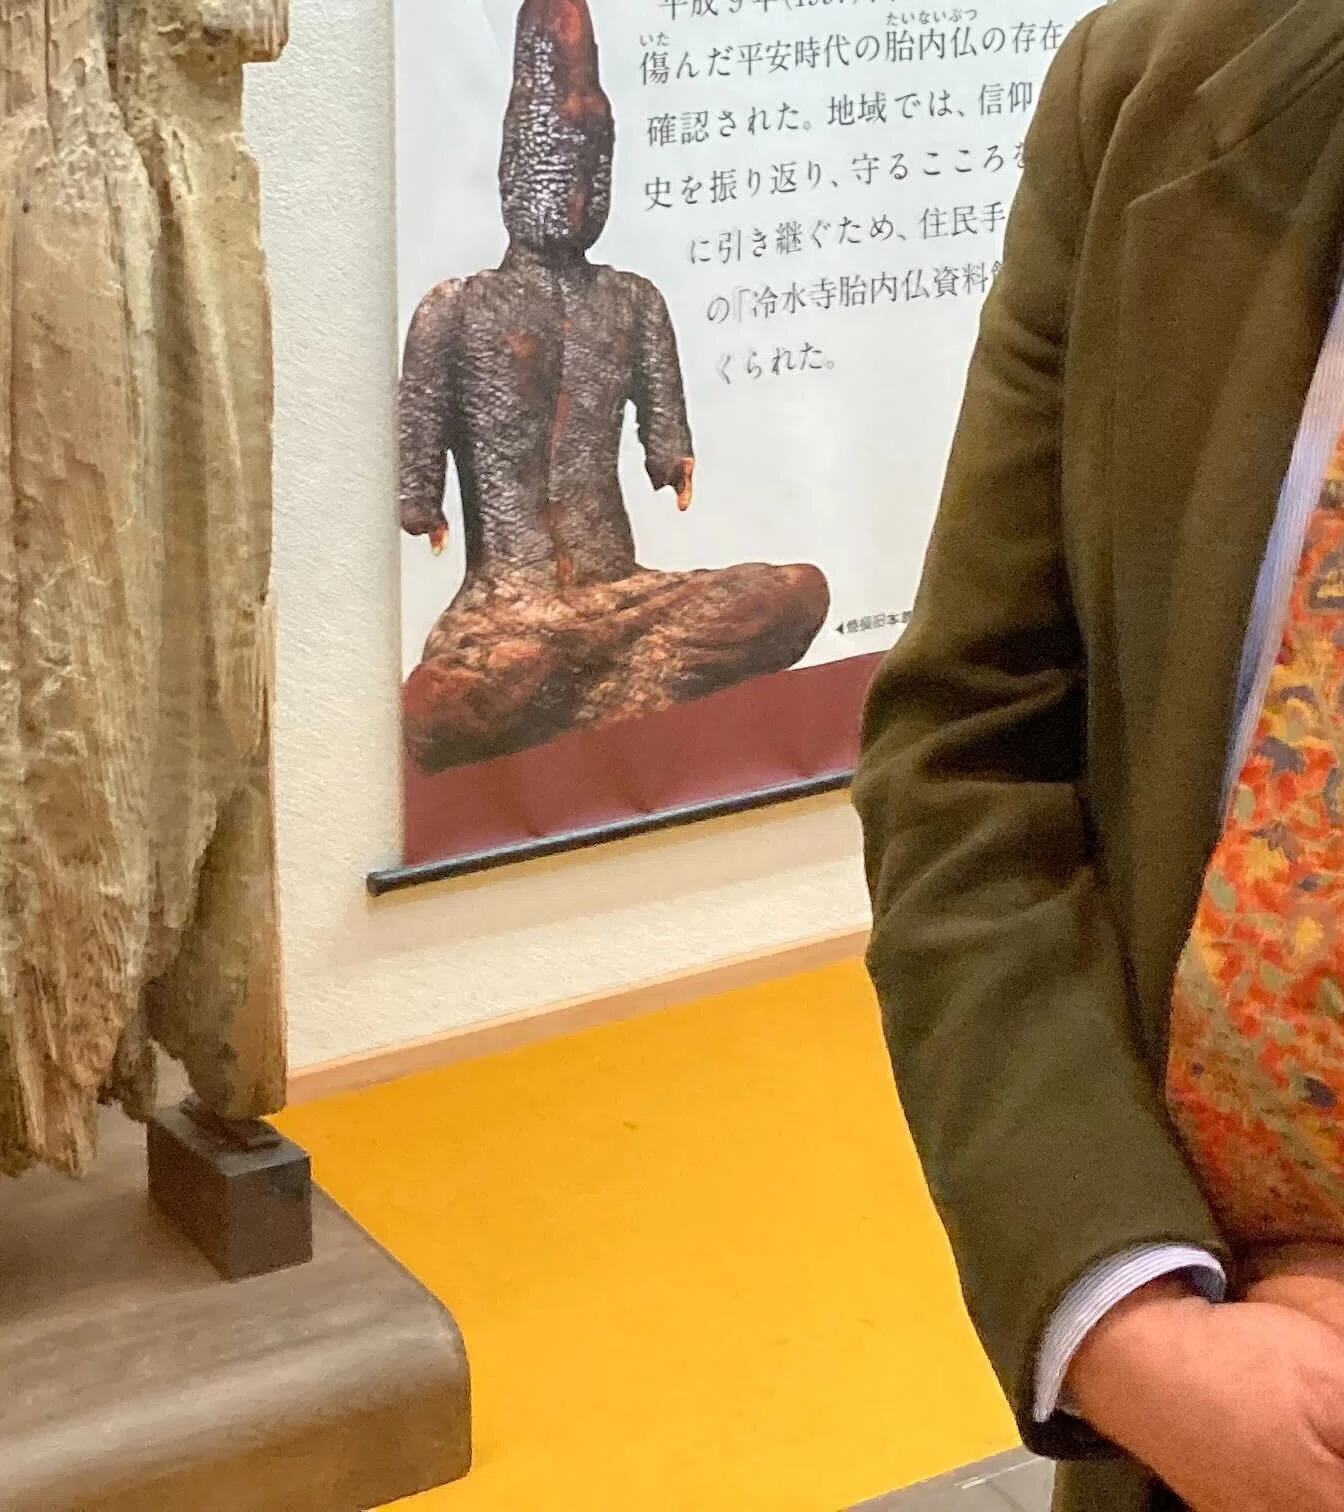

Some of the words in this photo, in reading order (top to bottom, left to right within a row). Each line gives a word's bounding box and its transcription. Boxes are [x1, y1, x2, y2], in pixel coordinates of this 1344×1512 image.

[639, 32, 670, 47] いた
[886, 7, 978, 26] たいないぶつ
[640, 20, 1082, 86] 傷んだ平安時代の胎内仏の存在
[648, 81, 1032, 147] 確認された。地域では、信仰
[691, 201, 1006, 264] に引き継ぐため、住民手
[717, 342, 835, 384] くられた。
